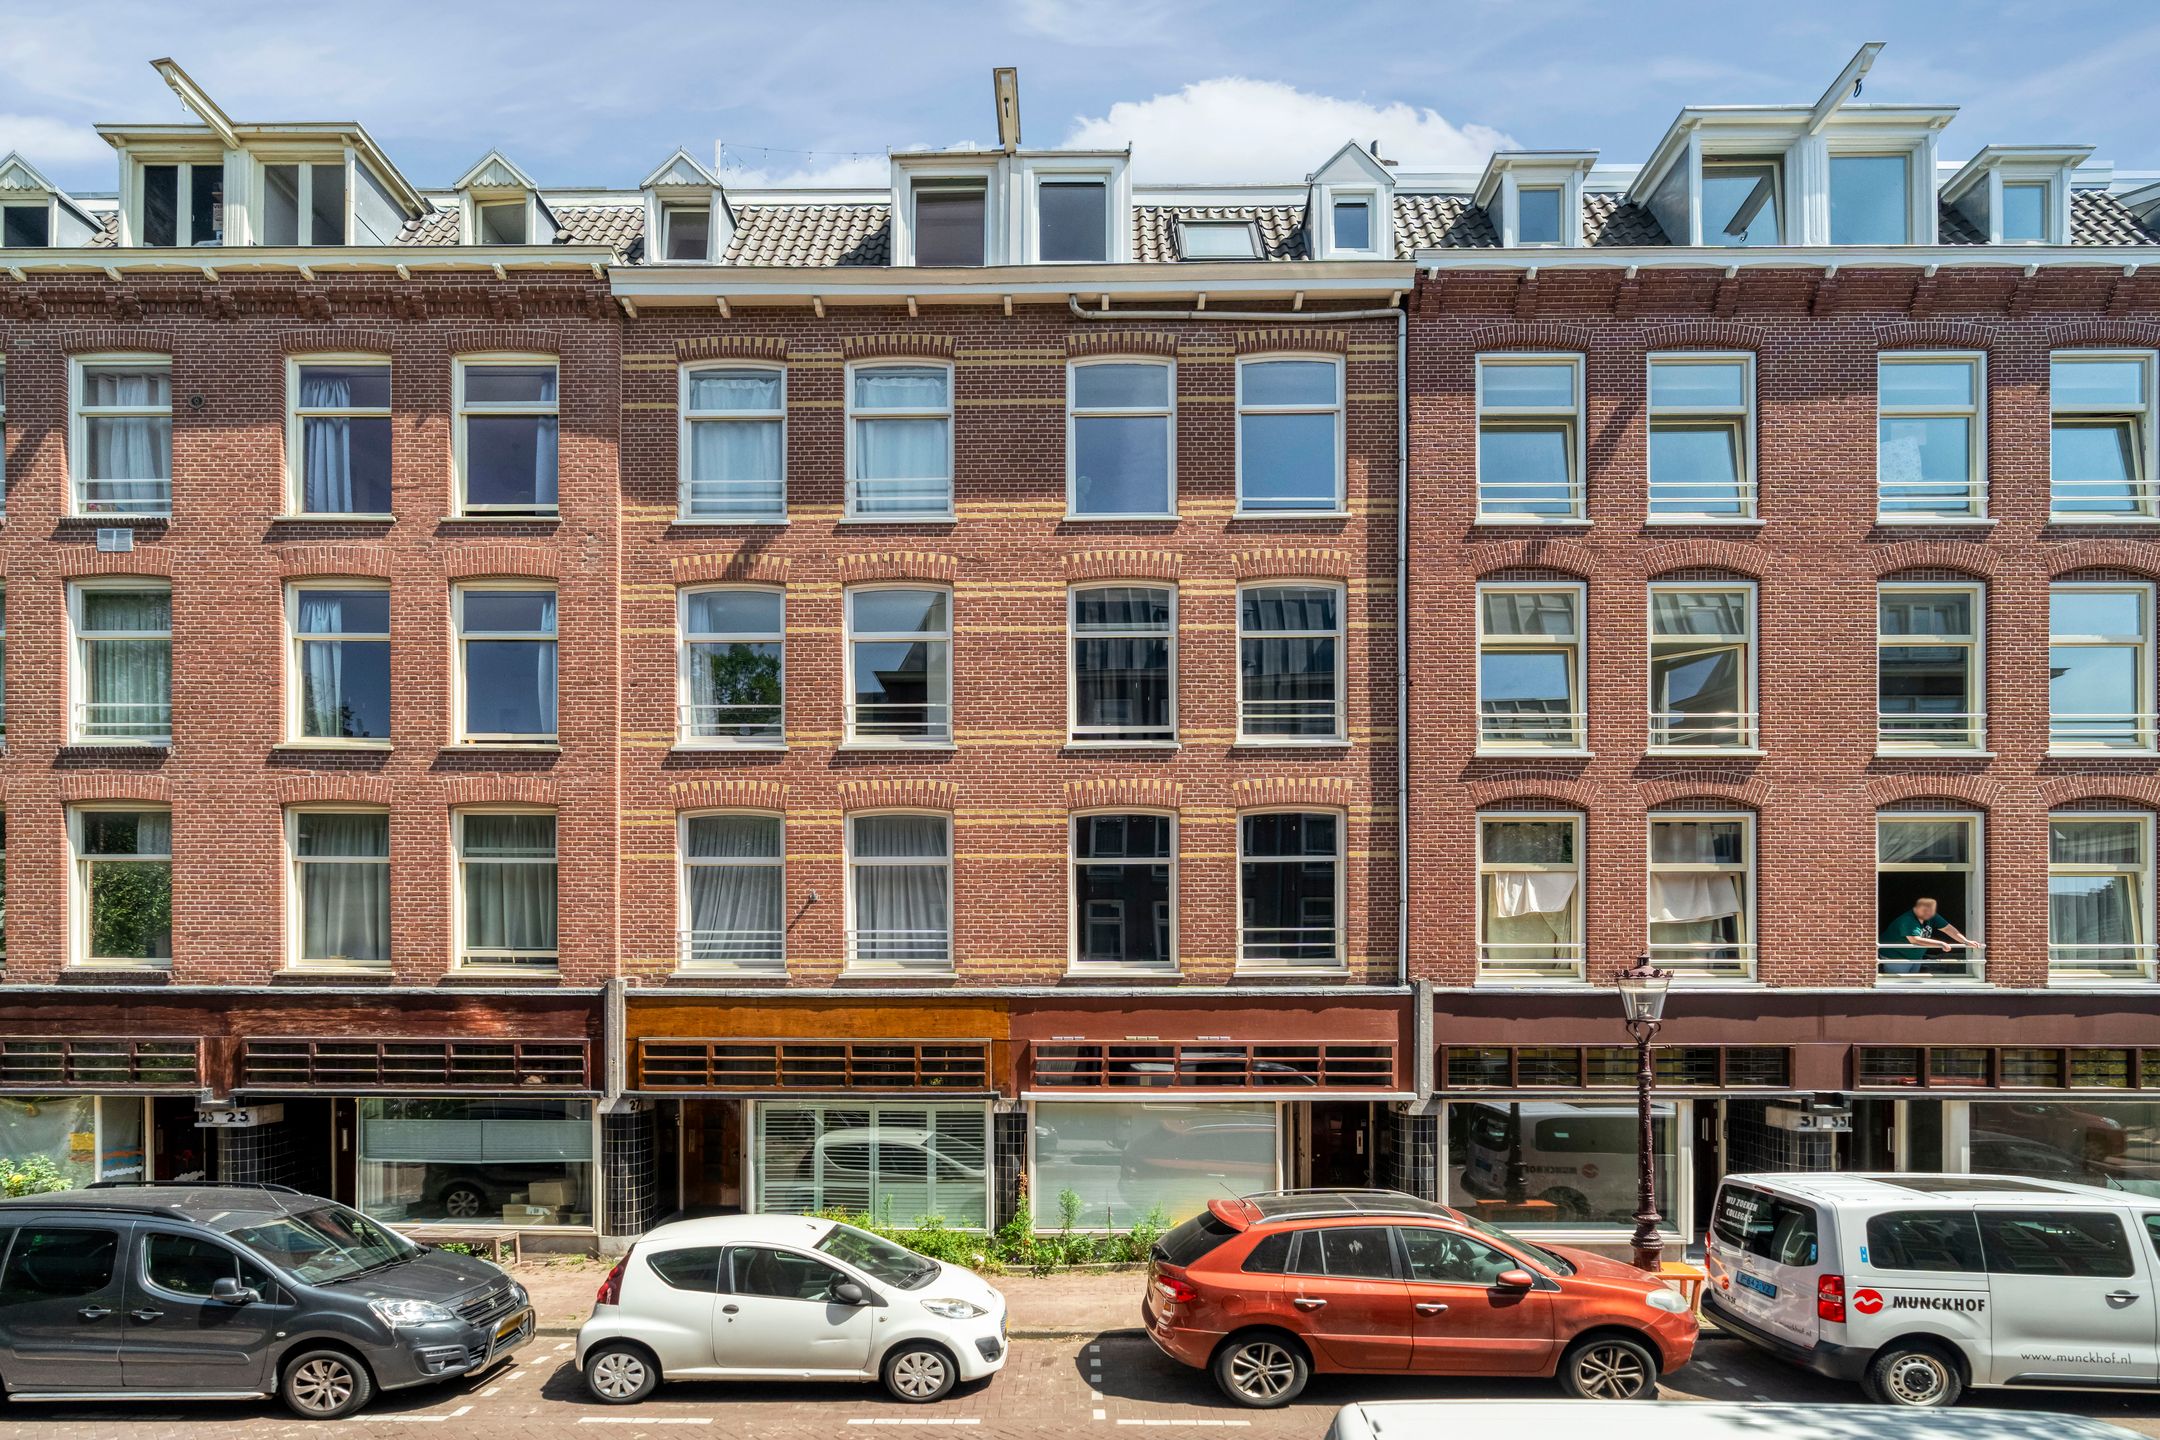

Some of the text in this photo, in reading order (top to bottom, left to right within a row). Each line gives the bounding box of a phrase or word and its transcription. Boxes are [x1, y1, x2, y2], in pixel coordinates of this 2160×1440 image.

[225, 1111, 248, 1122] 25
[1800, 1116, 1818, 1127] 31
[1735, 1198, 1759, 1212] ZOEKEN
[1892, 1296, 1985, 1312] MUNCKHOF
[2020, 1352, 2132, 1364] www.munckhof.nl
